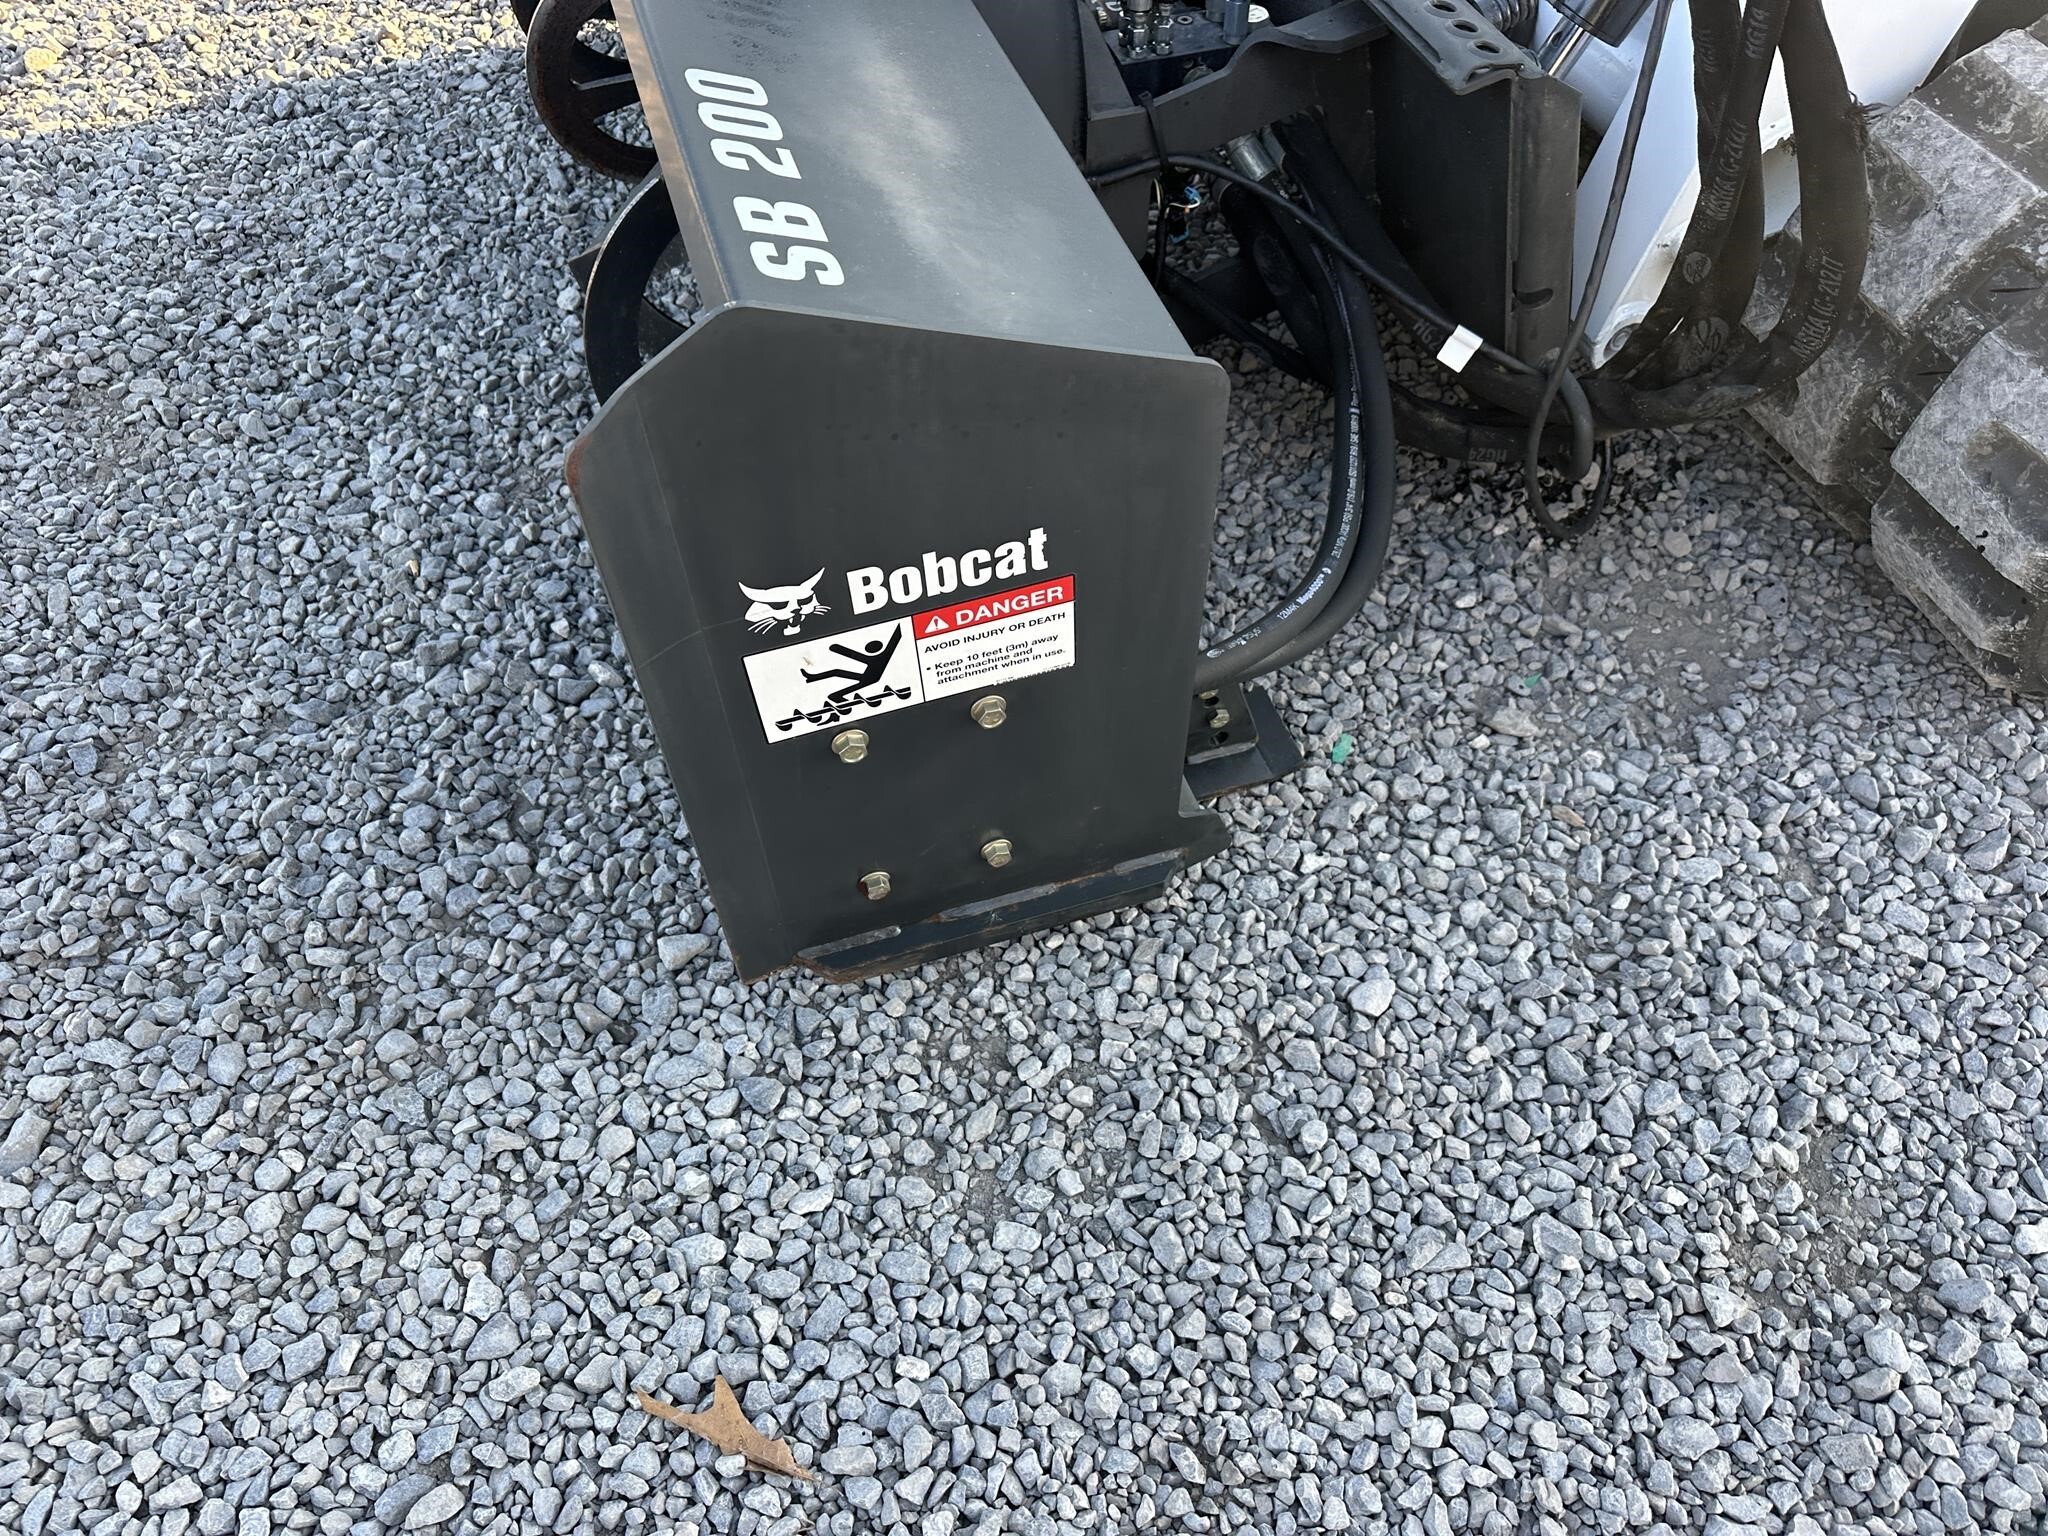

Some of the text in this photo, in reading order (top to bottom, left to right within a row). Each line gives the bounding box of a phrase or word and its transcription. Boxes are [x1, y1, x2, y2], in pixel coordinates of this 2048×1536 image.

[684, 68, 845, 286] SB 200
[1413, 320, 1443, 350] HG2
[846, 527, 1049, 616] Bobcat
[955, 585, 1064, 626] DANGER
[924, 612, 1066, 654] AVOID INJURY OR DEATH
[935, 634, 1059, 670] Keep 10 feet (3m) away
[936, 648, 1033, 678] from machine and
[937, 664, 999, 685] attachment
[1001, 657, 1030, 669] when
[1032, 653, 1042, 662] in
[1044, 648, 1066, 659] use.
